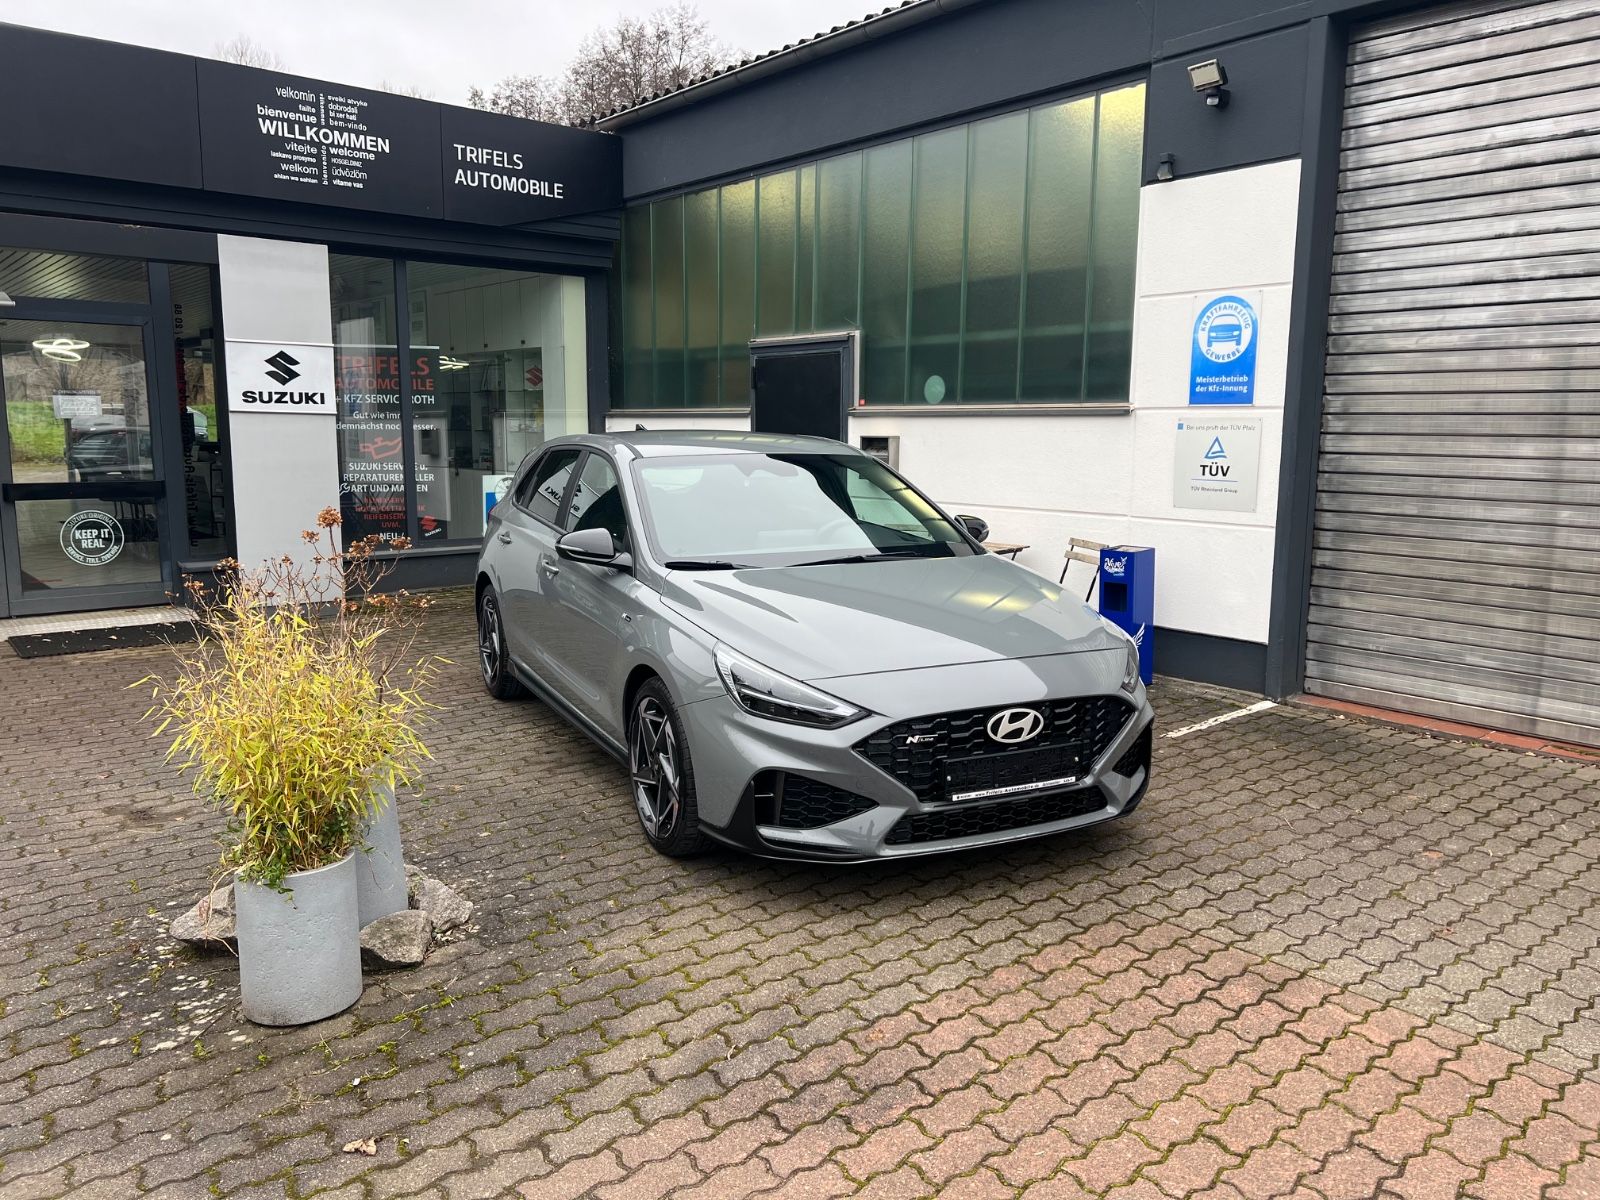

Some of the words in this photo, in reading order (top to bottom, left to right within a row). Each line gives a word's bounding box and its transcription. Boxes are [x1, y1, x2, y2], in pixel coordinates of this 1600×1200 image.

[276, 86, 316, 102] velkomin
[257, 104, 317, 124] bienvenue
[330, 118, 367, 131] bem-vindo
[258, 118, 390, 153] WILLKOMMEN
[284, 141, 318, 155] vitejte
[329, 147, 376, 161] welcome
[453, 143, 523, 170] TRIFELS
[280, 163, 319, 175] welkom
[454, 168, 564, 199] AUTOMOBILE
[1200, 303, 1251, 332] KRAFTFAHRZEUG
[1205, 347, 1242, 361] GEWERBE
[1196, 374, 1249, 384] Meisterbetrieb
[1195, 385, 1207, 393] der
[1208, 384, 1248, 394] Kfz-Innung
[241, 390, 326, 405] SUZUKI
[344, 394, 363, 404] KFZ
[353, 411, 369, 420] Gut
[370, 412, 385, 420] wie
[336, 421, 383, 430] demnächst
[349, 462, 381, 471] SUZUKI
[1200, 462, 1230, 477] TÜV
[351, 484, 367, 492] ART
[369, 484, 390, 493] UND
[75, 529, 98, 540] KEEP
[100, 528, 110, 538] IT
[81, 538, 105, 549] REAL
